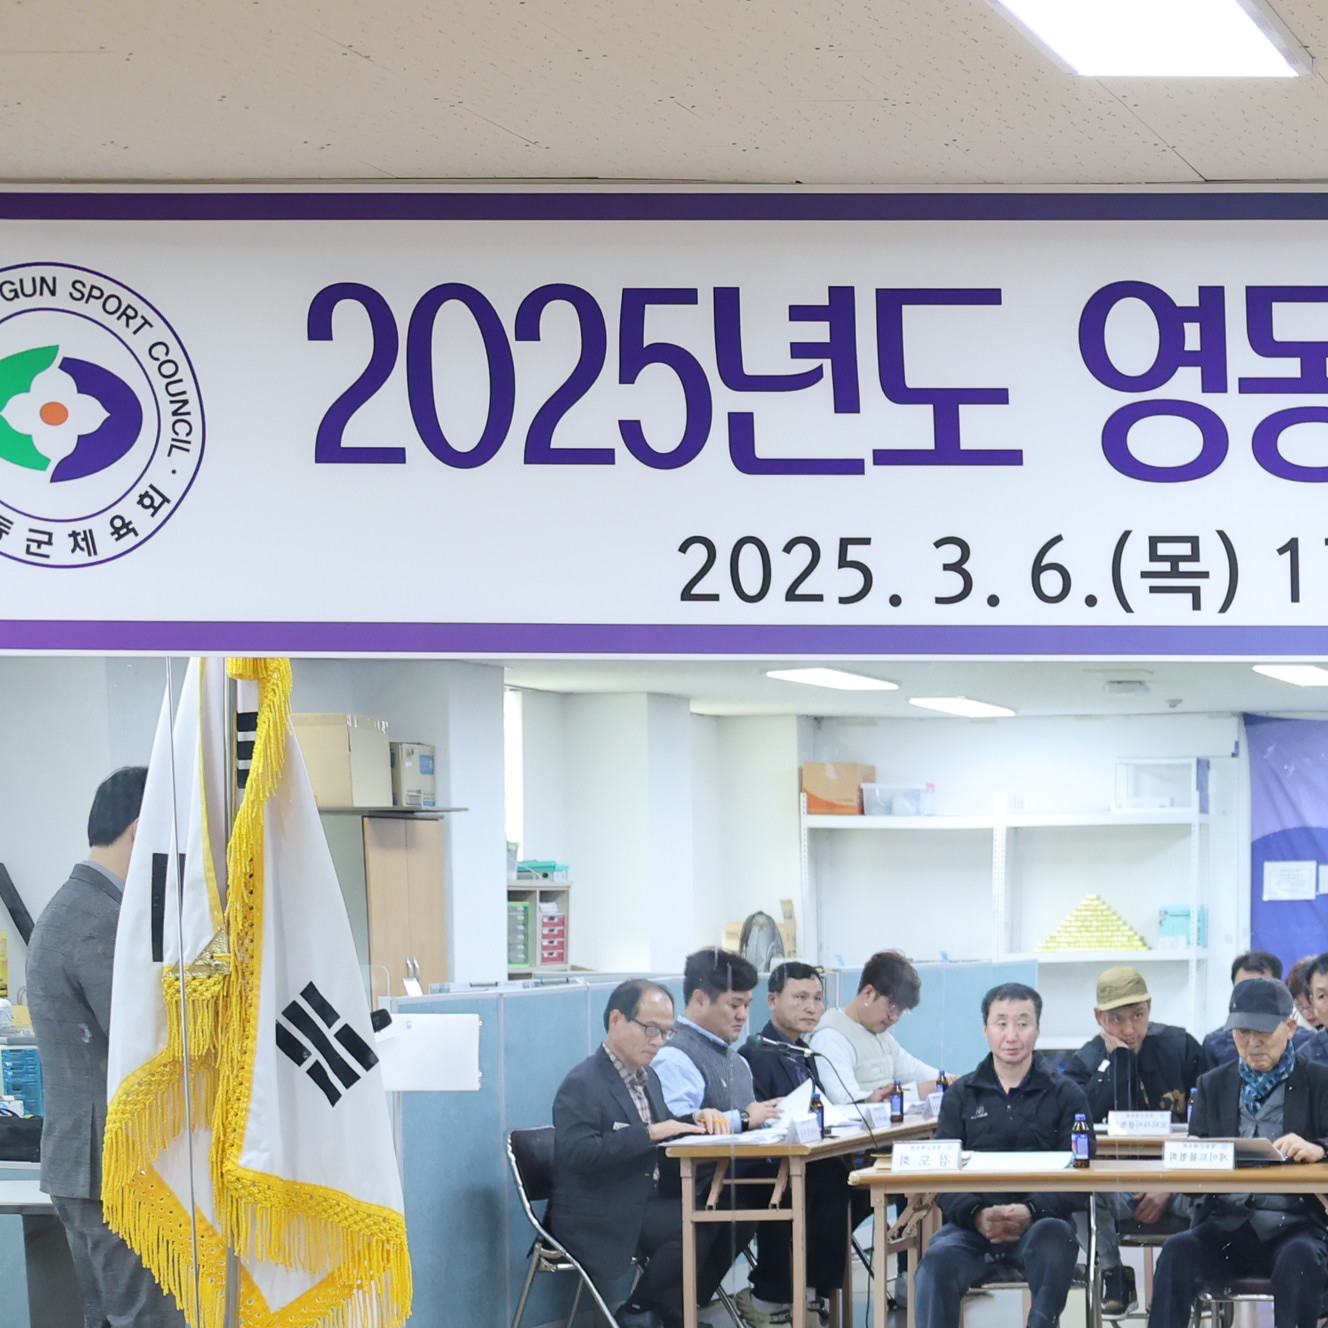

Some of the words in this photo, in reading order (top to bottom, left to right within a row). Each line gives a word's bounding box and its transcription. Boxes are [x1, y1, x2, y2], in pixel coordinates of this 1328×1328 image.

[69, 280, 153, 335] SPORT
[148, 341, 193, 459] COUNCIL
[307, 282, 1023, 475] 2025년도
[678, 536, 901, 607] 2025.
[934, 537, 1001, 608] 3.
[1032, 530, 1239, 613] 6.(목)
